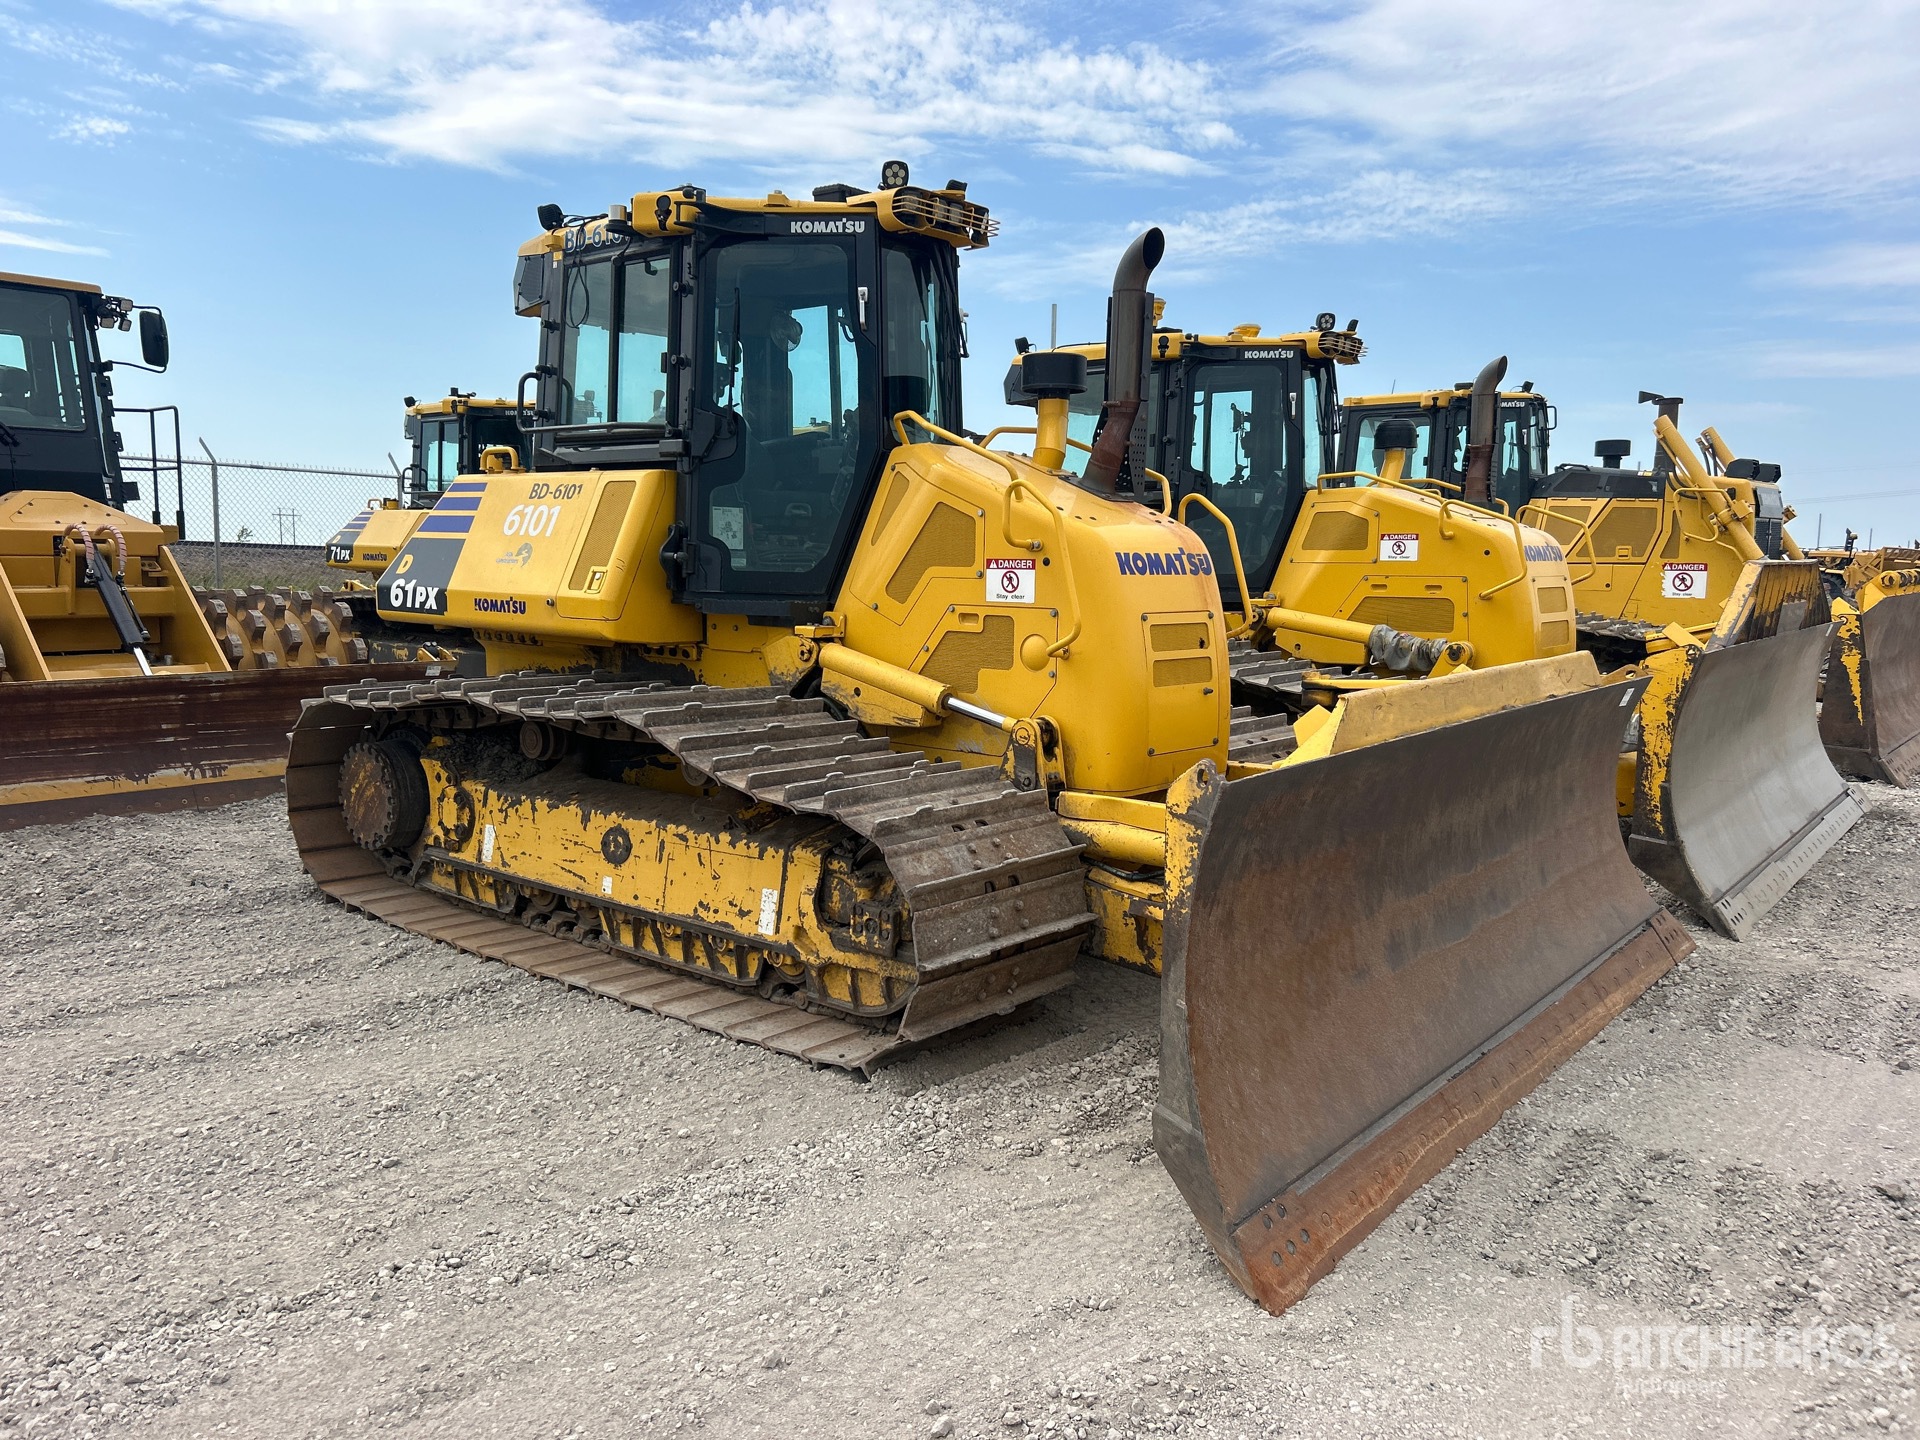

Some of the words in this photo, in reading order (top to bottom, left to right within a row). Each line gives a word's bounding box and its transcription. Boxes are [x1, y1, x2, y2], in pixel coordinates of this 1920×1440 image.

[790, 217, 865, 234] KOMATSU
[563, 223, 630, 253] BD-610
[1244, 348, 1294, 359] KOMATSU
[528, 482, 583, 500] BD-6101
[503, 504, 562, 537] 6101
[331, 546, 351, 560] 71PX
[362, 550, 388, 562] KOMATSU
[1524, 541, 1563, 562] KOMATSU
[396, 554, 414, 575] D
[998, 559, 1033, 569] DANGER
[1115, 547, 1213, 576] KOMATSU
[1672, 563, 1705, 571] DANGER
[390, 578, 440, 610] 61PX
[474, 596, 526, 615] KOMATSU
